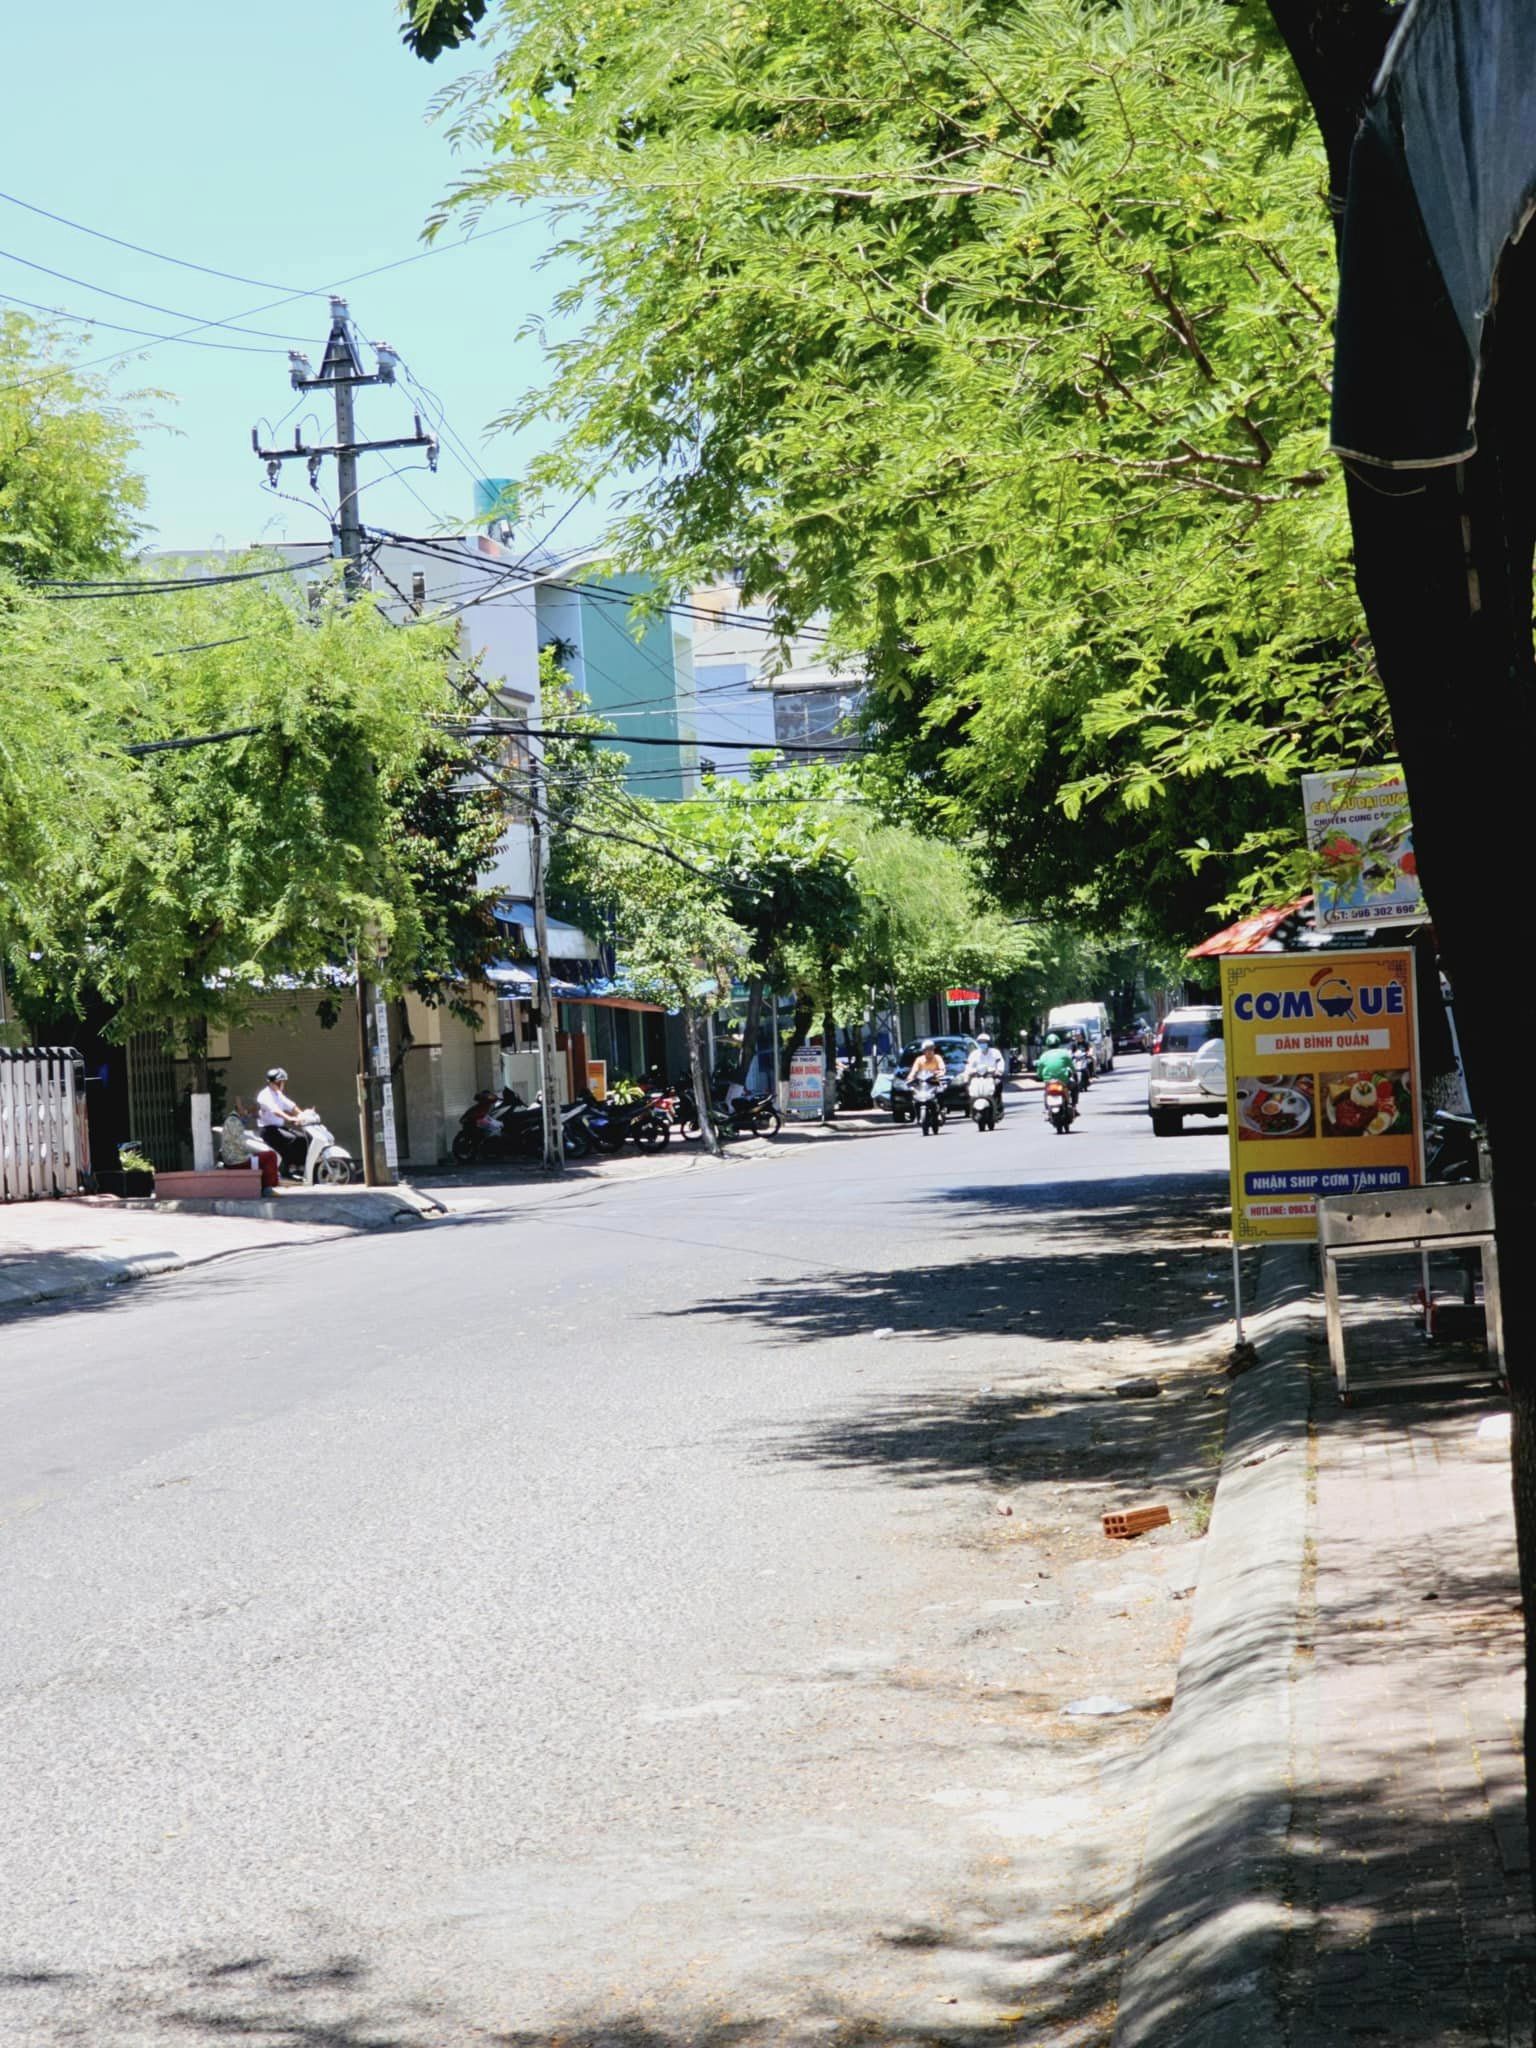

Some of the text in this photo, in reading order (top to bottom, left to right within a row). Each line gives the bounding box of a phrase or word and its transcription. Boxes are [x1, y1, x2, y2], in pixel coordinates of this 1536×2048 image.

[1349, 813, 1372, 823] CUNG
[1374, 906, 1393, 916] 302
[1234, 991, 1314, 1020] CƠM
[1304, 1034, 1332, 1049] BÌNH
[1252, 1175, 1287, 1191] NHẬN
[1290, 1175, 1318, 1188] SHIP
[1321, 1173, 1349, 1186] CƠM
[1379, 1169, 1401, 1184] NƠI
[1250, 1205, 1287, 1217] HOTLINE:
